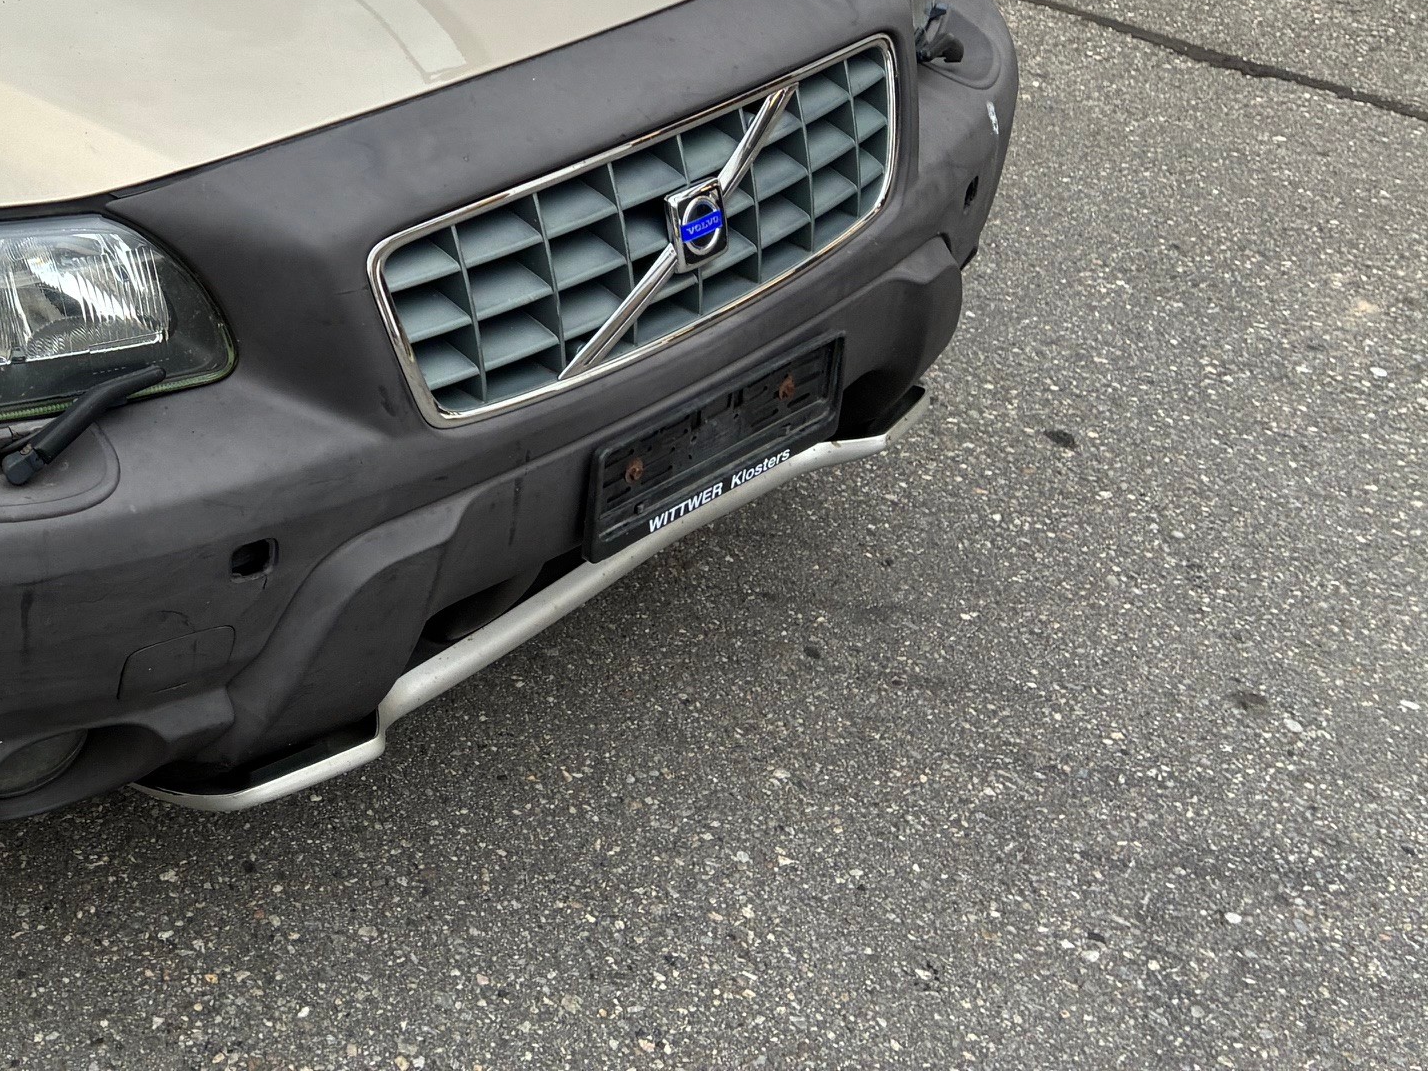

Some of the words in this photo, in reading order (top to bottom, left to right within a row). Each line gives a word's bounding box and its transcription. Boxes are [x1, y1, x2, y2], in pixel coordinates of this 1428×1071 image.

[685, 215, 720, 235] VOLVO
[648, 481, 723, 533] WITTWER
[730, 448, 791, 490] Klosters
